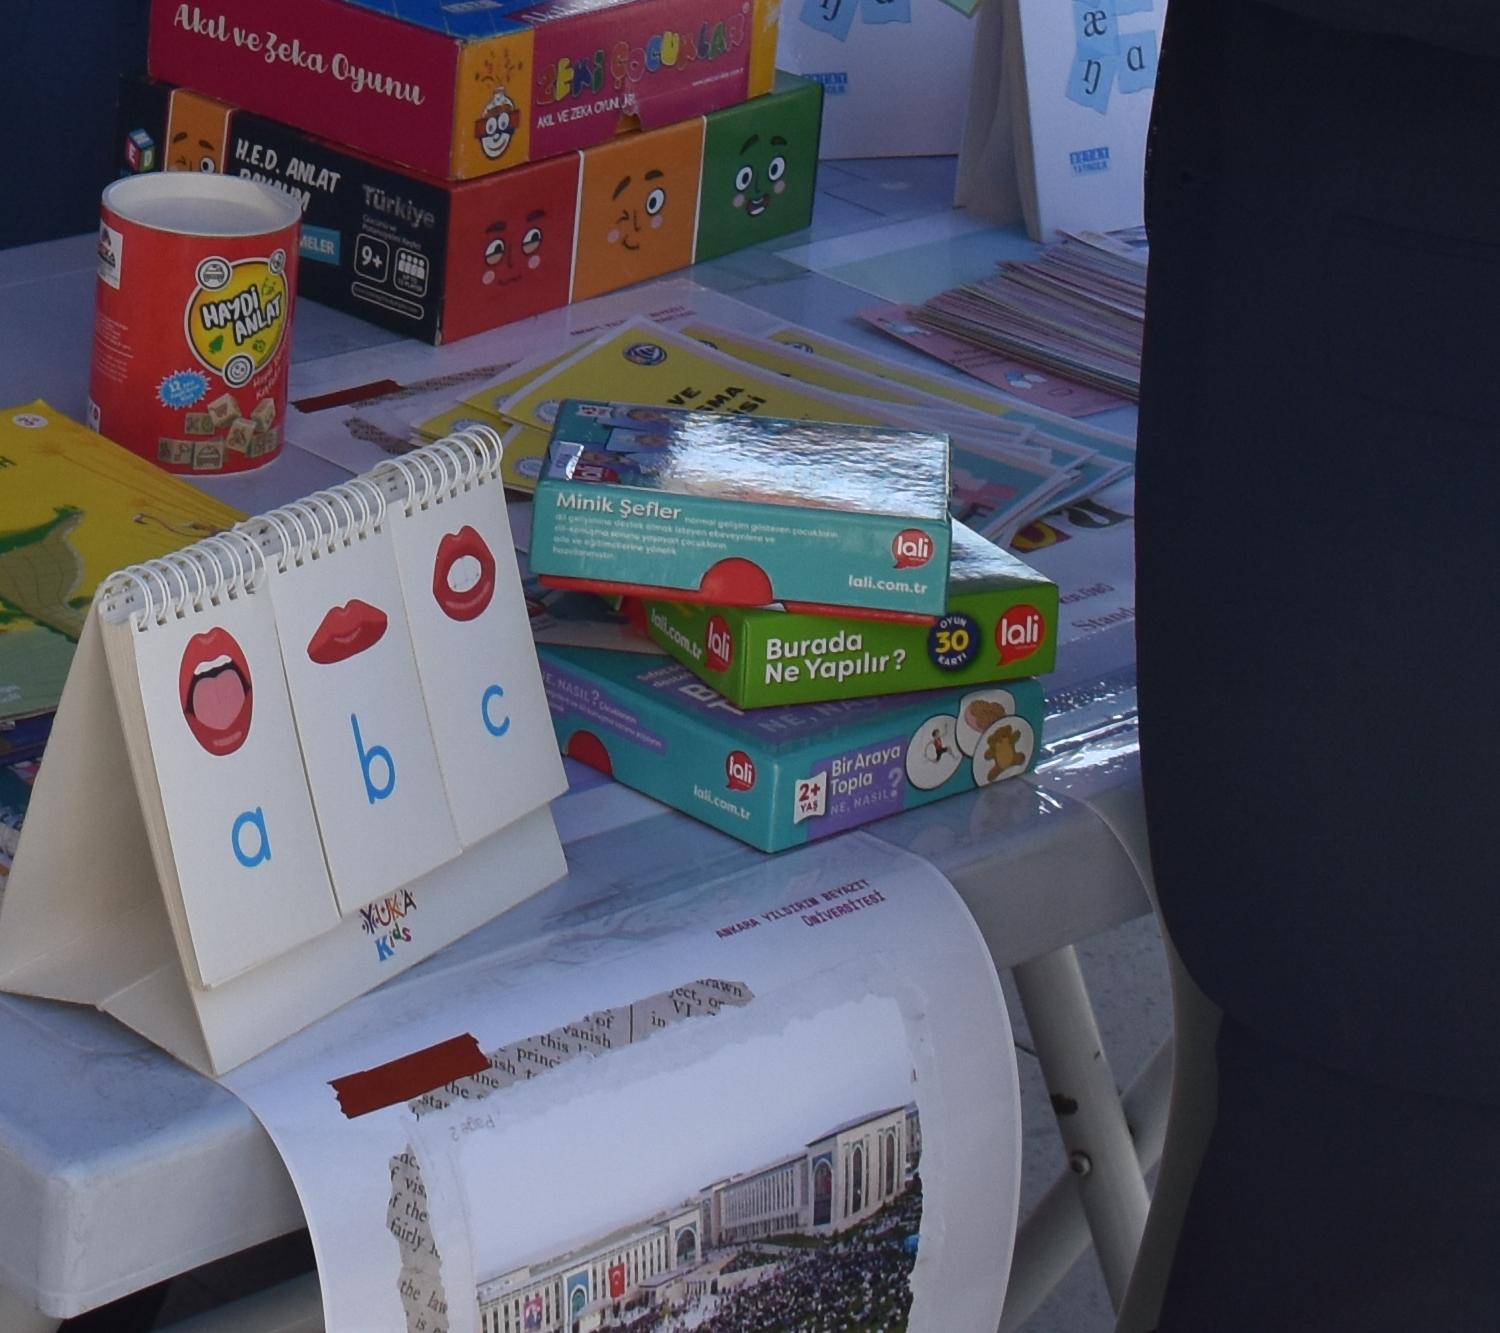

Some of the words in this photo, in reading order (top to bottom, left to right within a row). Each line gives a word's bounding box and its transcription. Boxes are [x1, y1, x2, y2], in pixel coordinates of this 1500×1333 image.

[174, 4, 230, 43] Akıl
[232, 26, 263, 52] ve
[263, 31, 328, 75] Zeka
[331, 53, 426, 106] Oyunu
[556, 109, 570, 125] VE
[569, 103, 594, 121] ZEKA
[235, 137, 281, 175] H.E.D.
[285, 156, 341, 195] ANLAT
[362, 183, 436, 229] Türkiye
[361, 245, 383, 269] 9+
[201, 285, 260, 330] HAYDİ
[234, 293, 283, 346] ANLAT
[666, 386, 702, 406] VE
[556, 492, 615, 514] Minik
[620, 499, 683, 521] Şefler
[897, 534, 929, 561] lali
[848, 573, 928, 595] lali.com.tr
[650, 607, 703, 660] lali.com.tr
[938, 616, 967, 630] OYUN
[1000, 613, 1040, 647] lali
[705, 620, 732, 661] lali
[764, 630, 863, 663] Burada
[934, 629, 971, 654] 30
[764, 662, 801, 686] Ne
[936, 652, 968, 669] KARTI
[728, 756, 753, 785] lali
[832, 757, 854, 777] Bir
[854, 745, 901, 771] Araya
[230, 806, 273, 869] a
[350, 712, 397, 805] b
[480, 683, 511, 738] c
[830, 772, 873, 796] Topla
[693, 784, 751, 820] lali.com.tr
[798, 782, 821, 803] 2+
[800, 800, 819, 814] YAŞ
[360, 890, 418, 934] YUKA
[715, 918, 762, 939] ANKARA
[761, 896, 821, 923] YILDIRIM
[820, 878, 872, 902] BEYAZIT
[800, 889, 887, 928] ÜNİVERSİTESİ
[375, 924, 413, 962] Kids
[540, 1034, 569, 1054] this
[405, 1200, 428, 1223] the
[390, 1216, 426, 1253] fairly
[399, 1279, 421, 1301] the
[415, 1315, 427, 1331] is
